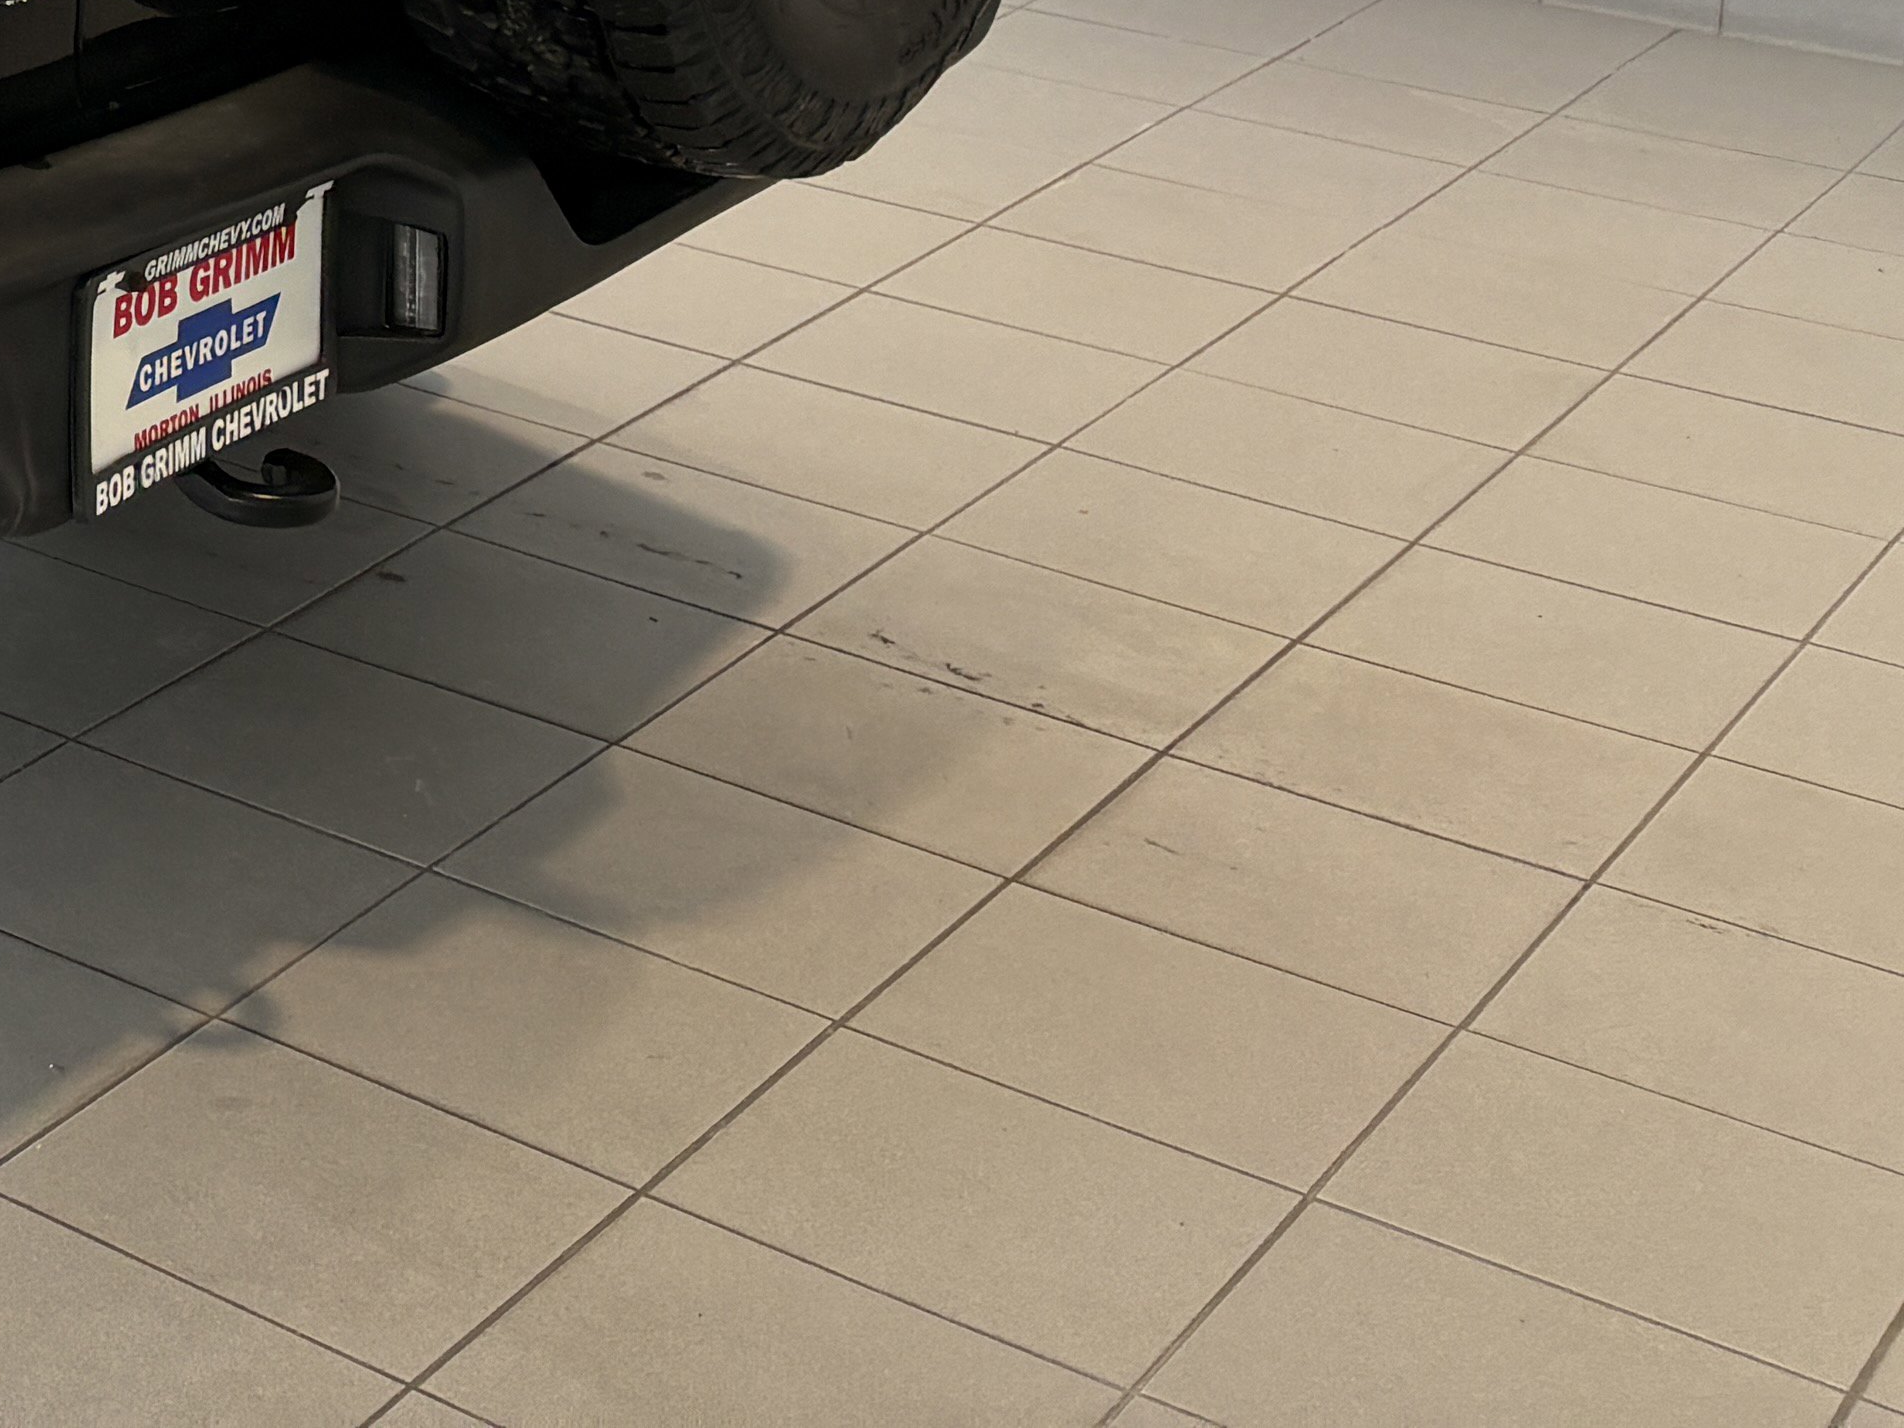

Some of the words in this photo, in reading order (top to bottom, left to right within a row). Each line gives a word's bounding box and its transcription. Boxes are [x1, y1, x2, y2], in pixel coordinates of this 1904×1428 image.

[113, 272, 178, 339] BOB
[189, 222, 297, 303] GRIMM
[144, 202, 286, 281] GRIMMCHEVY.COM
[139, 310, 267, 392] CHEVROLET
[96, 464, 136, 516] BOB
[141, 426, 207, 489] GRIMM
[212, 368, 330, 452] CHEVROLET
[134, 403, 200, 452] MORTON
[209, 368, 273, 414] ILLINOIS
